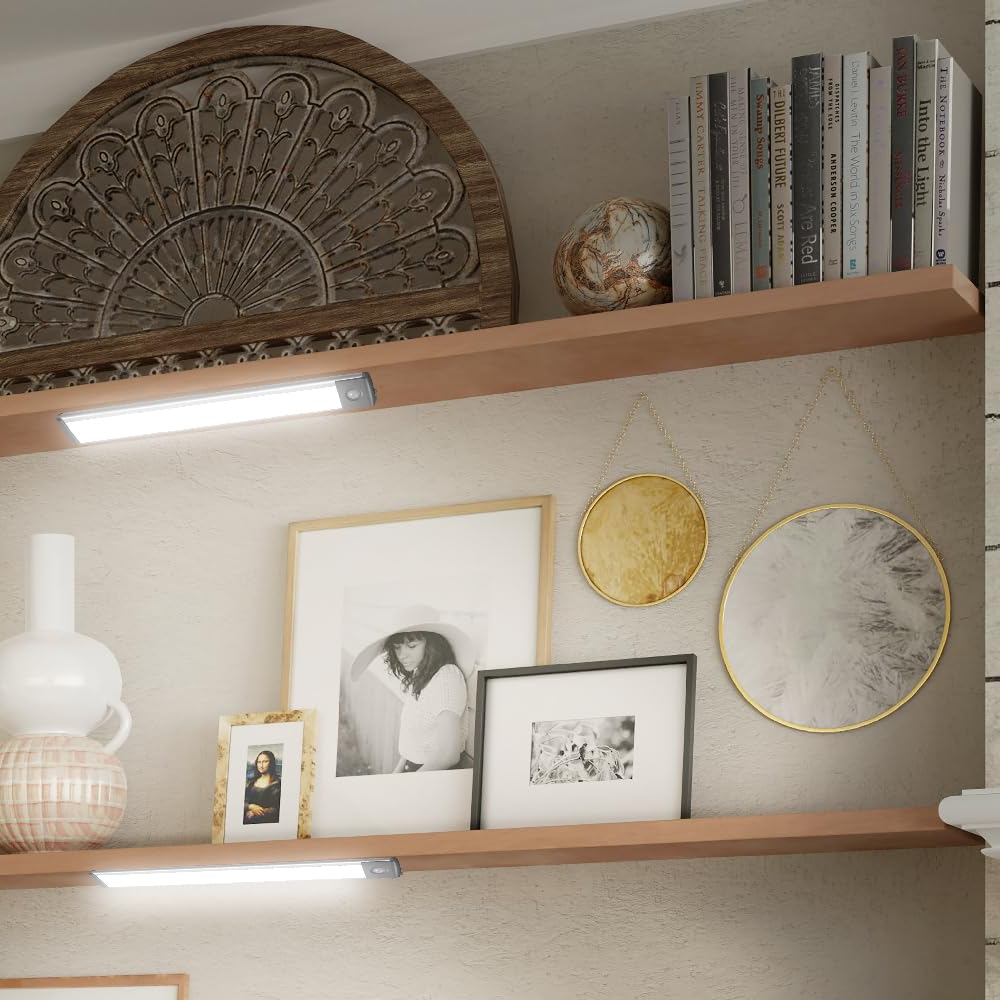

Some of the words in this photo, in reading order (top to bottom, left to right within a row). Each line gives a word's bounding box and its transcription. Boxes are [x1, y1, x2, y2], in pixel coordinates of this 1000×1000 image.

[939, 67, 948, 90] THE
[755, 94, 765, 134] Swamp
[774, 101, 785, 144] DILBERT
[918, 99, 931, 132] Into
[939, 96, 947, 156] NOTEBOOK
[696, 125, 704, 176] CARTER
[755, 137, 765, 169] Songs
[851, 131, 860, 152] The
[917, 137, 930, 162] the
[774, 148, 786, 188] FUTURE
[850, 155, 860, 187] World
[851, 192, 858, 200] in
[915, 166, 930, 207] Light
[697, 187, 706, 242] TALKING
[801, 204, 816, 230] Are
[850, 202, 859, 219] Six
[937, 211, 945, 237] Sparks
[801, 234, 817, 264] Red
[847, 220, 859, 251] Songs
